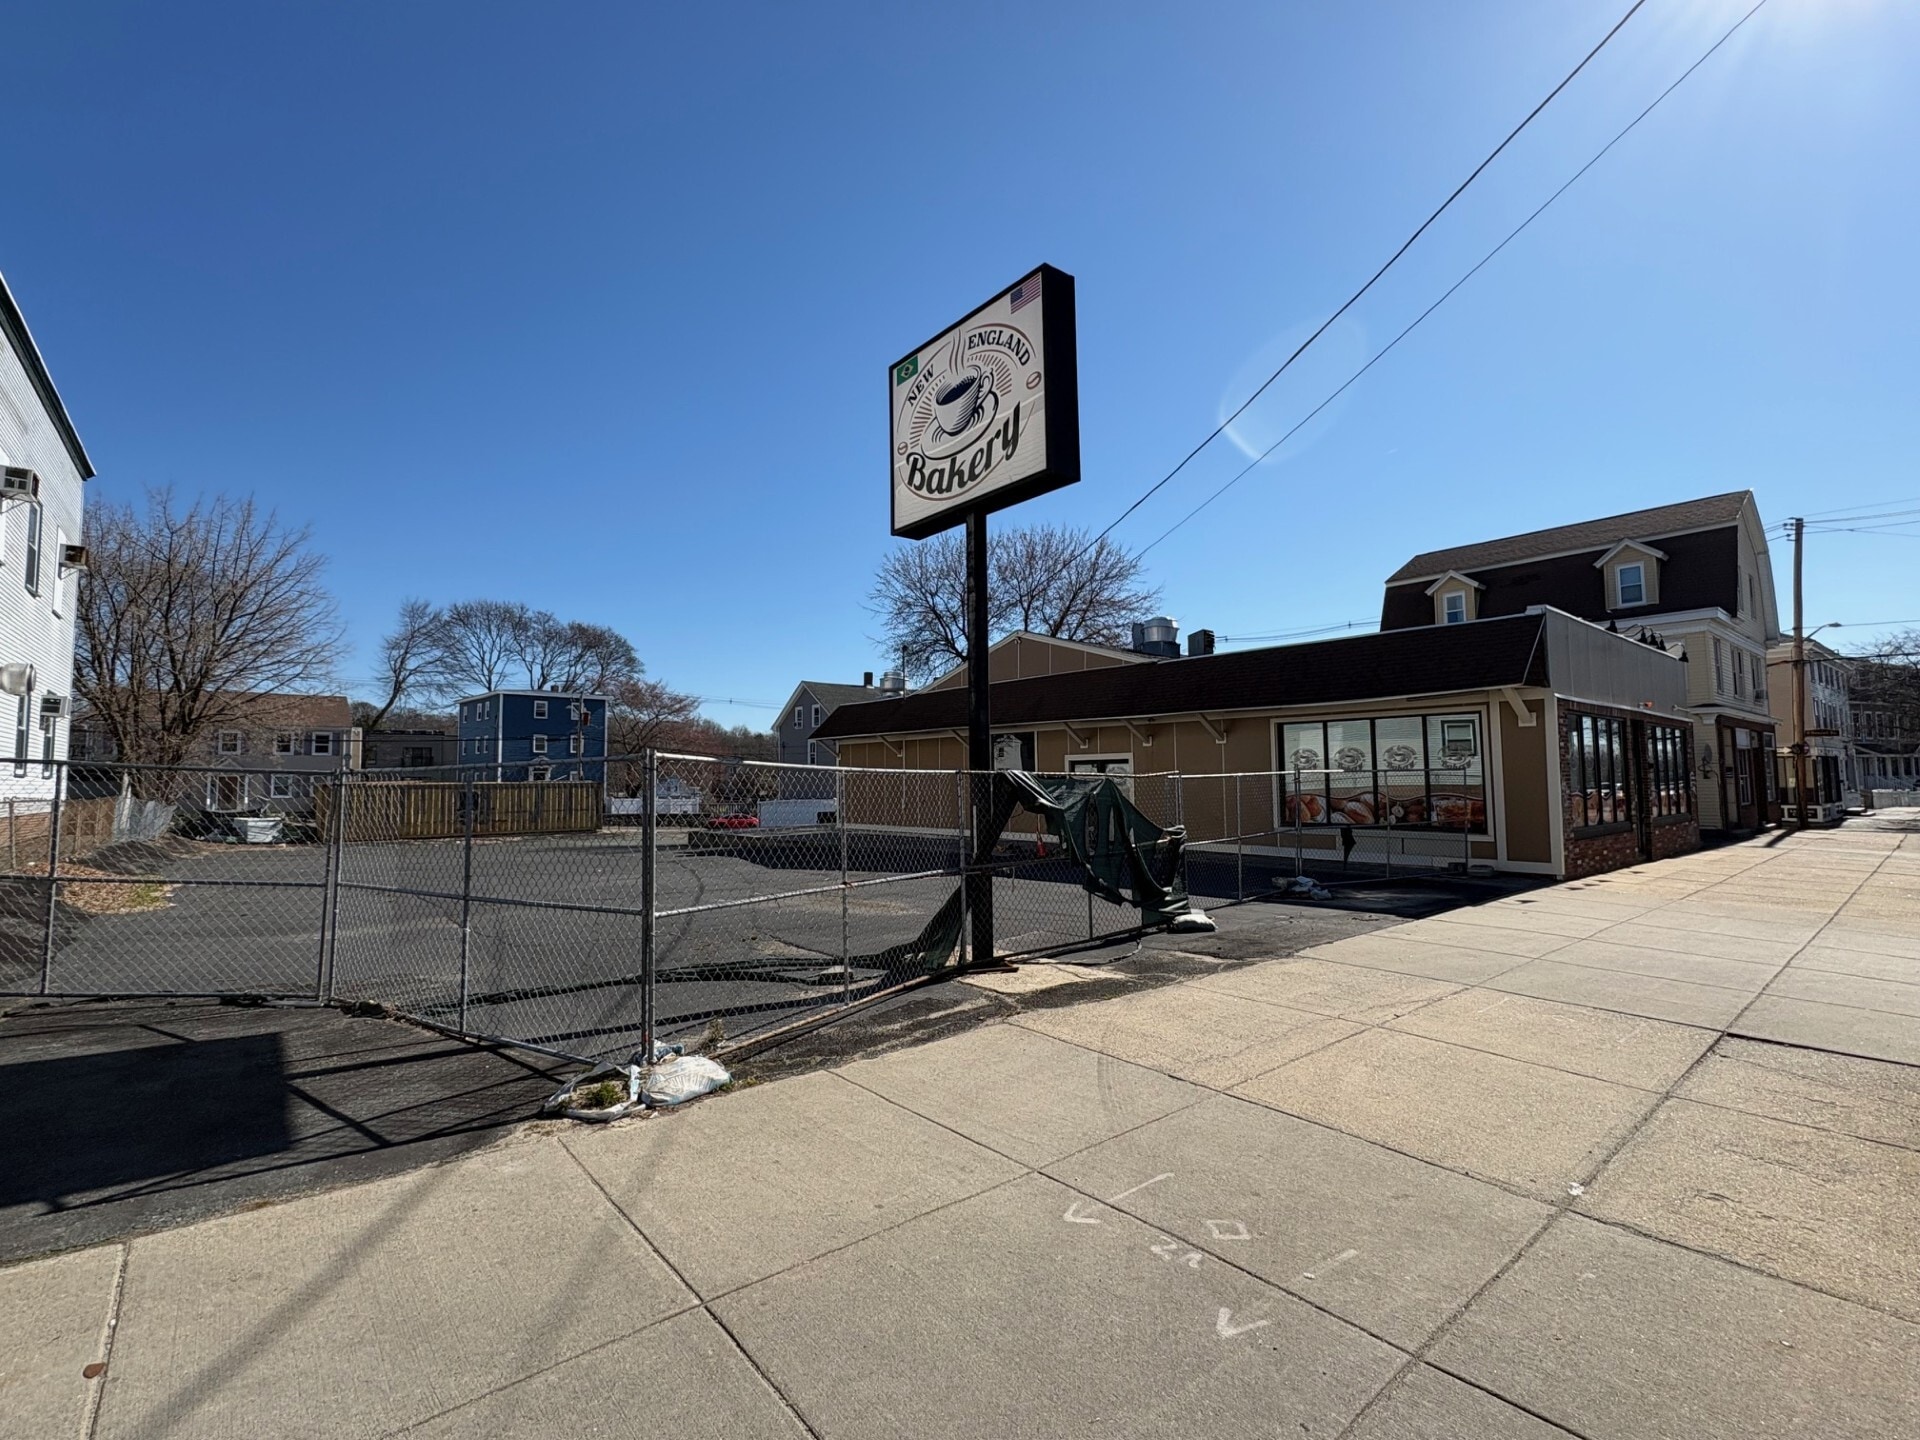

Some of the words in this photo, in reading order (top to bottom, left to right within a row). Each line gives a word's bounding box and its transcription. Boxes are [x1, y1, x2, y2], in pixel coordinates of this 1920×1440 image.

[908, 364, 935, 407] NEW
[967, 330, 1030, 366] ENGLAND
[907, 401, 1021, 495] Bakery
